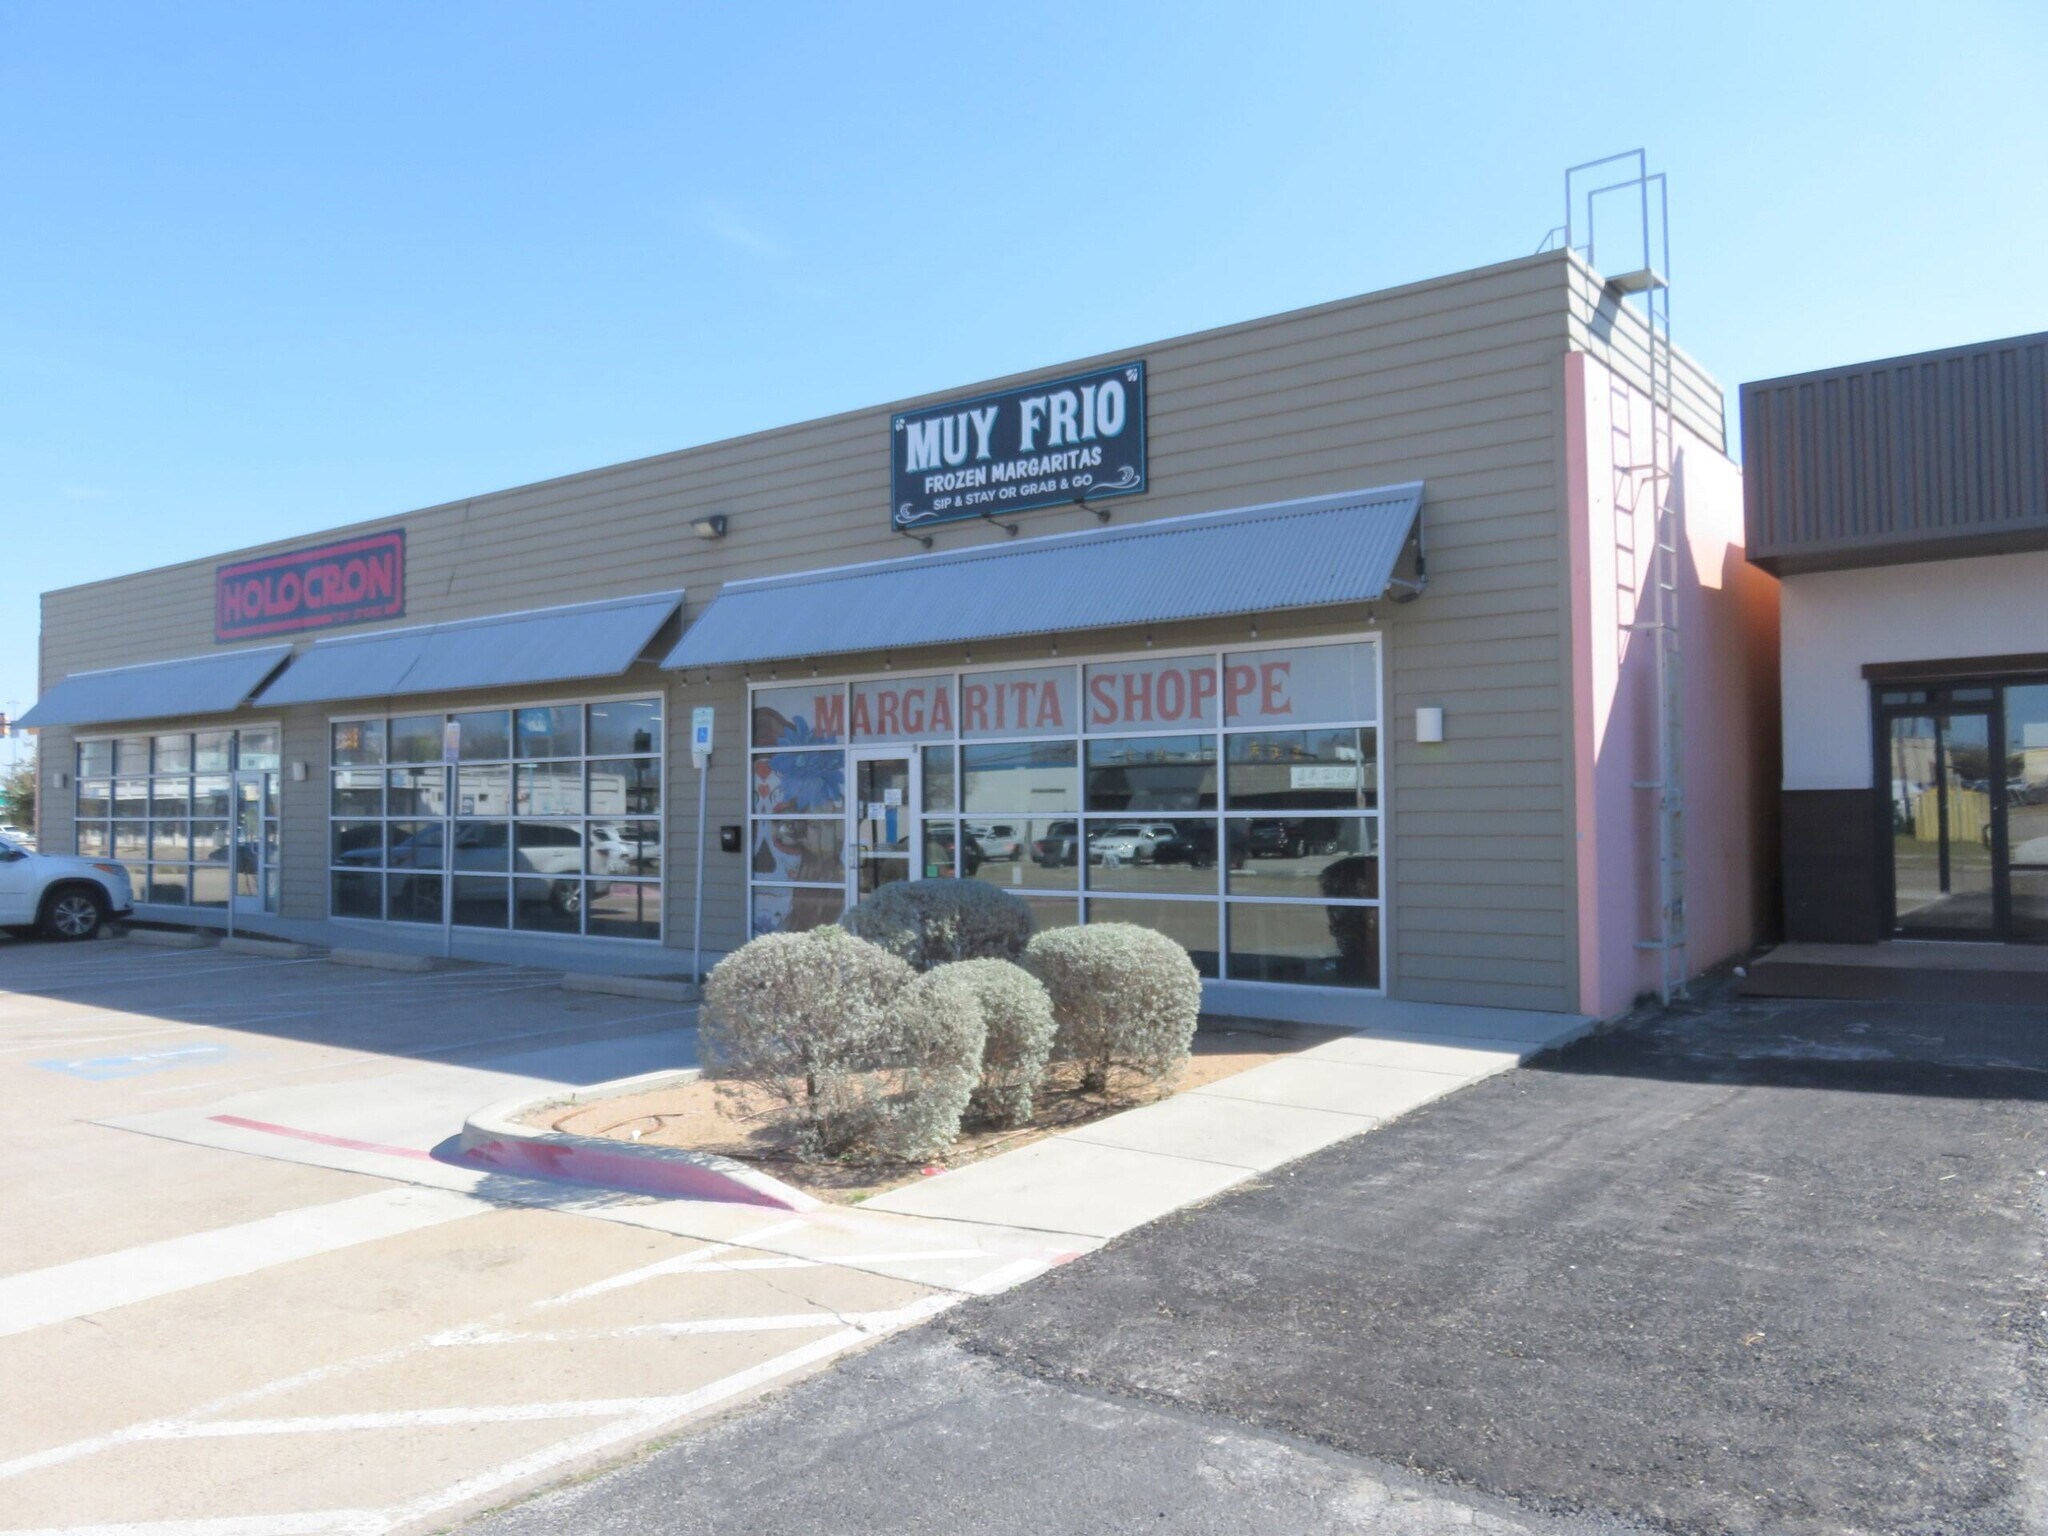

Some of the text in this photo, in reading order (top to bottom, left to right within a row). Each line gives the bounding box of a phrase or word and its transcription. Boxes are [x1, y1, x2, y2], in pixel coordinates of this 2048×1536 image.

[906, 380, 1126, 473] MUY FRIO
[924, 446, 1102, 494] FROZEN MARGARITAS
[933, 474, 1093, 511] SIP & STAY OR GRAB & GO
[224, 552, 393, 623] HOLOCRON
[814, 661, 1292, 736] MARGARITA SHOPPE
